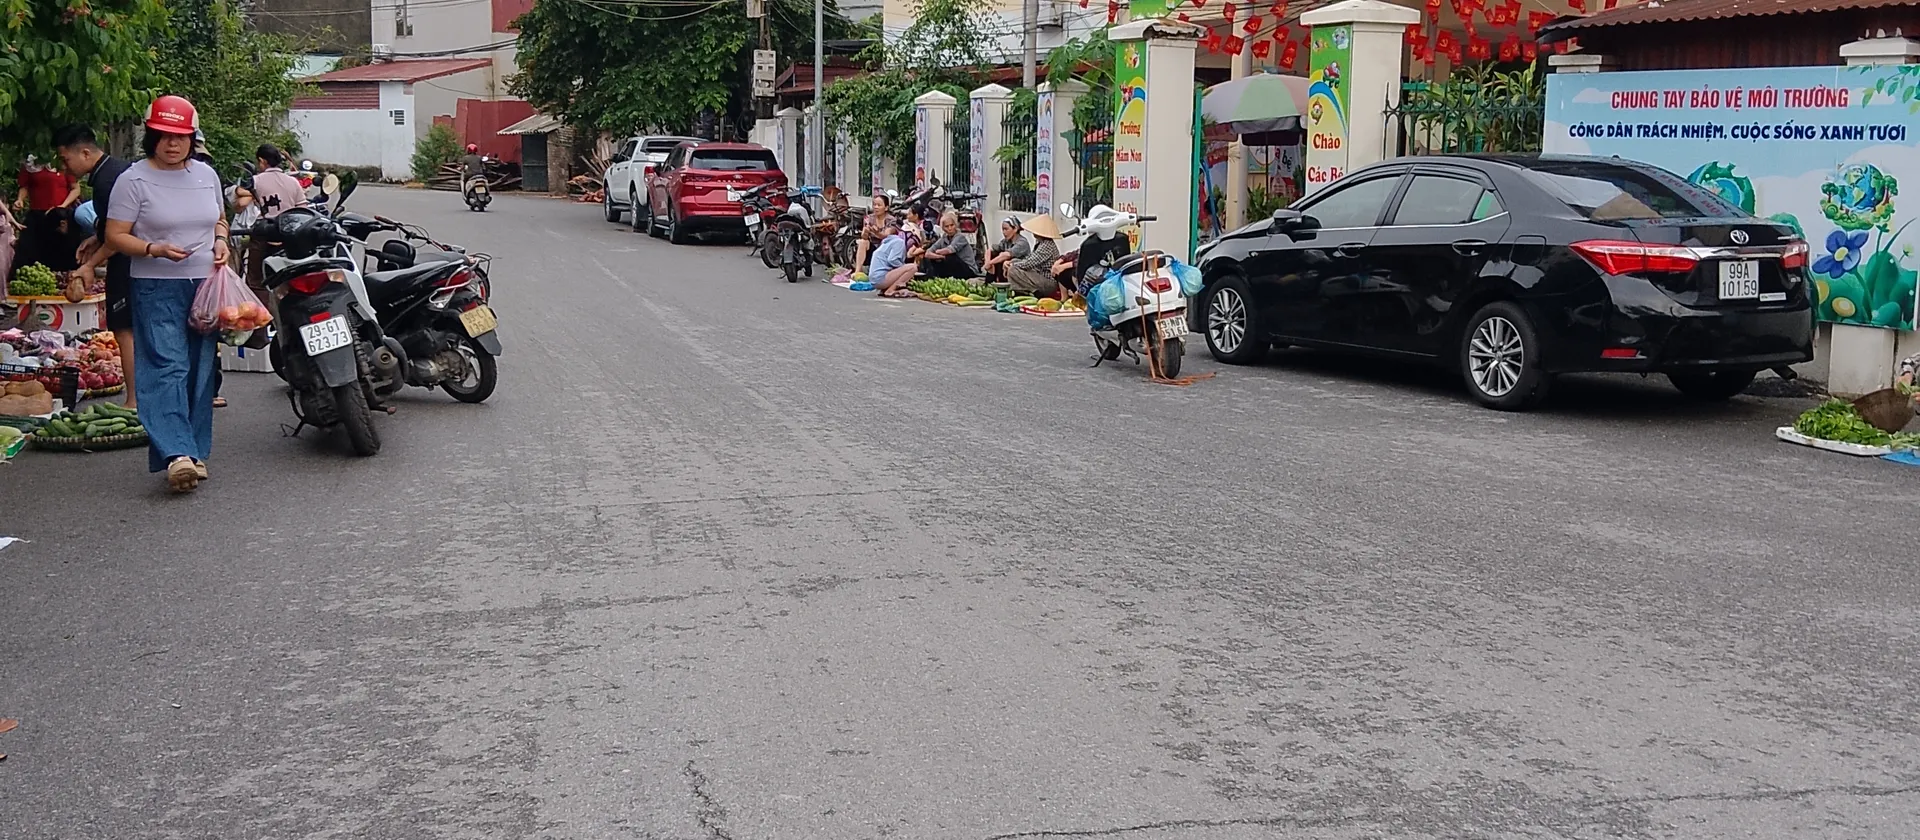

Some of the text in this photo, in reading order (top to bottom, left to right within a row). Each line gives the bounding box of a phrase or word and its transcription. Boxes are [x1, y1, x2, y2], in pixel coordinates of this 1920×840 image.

[1611, 83, 1849, 113] CHUNG TAY BẢO VỆ MÔI TRƯỜNG
[1568, 119, 1907, 143] CÔNG DÂN TRÁCH NHIỆM, CUỘC SỐNG XANH TƯƠI
[1312, 132, 1341, 150] Chào
[1307, 165, 1327, 183] Các
[1728, 262, 1750, 280] 99A
[1722, 279, 1757, 297] 101.59
[307, 319, 340, 339] 29-G1
[308, 331, 349, 353] 623.73
